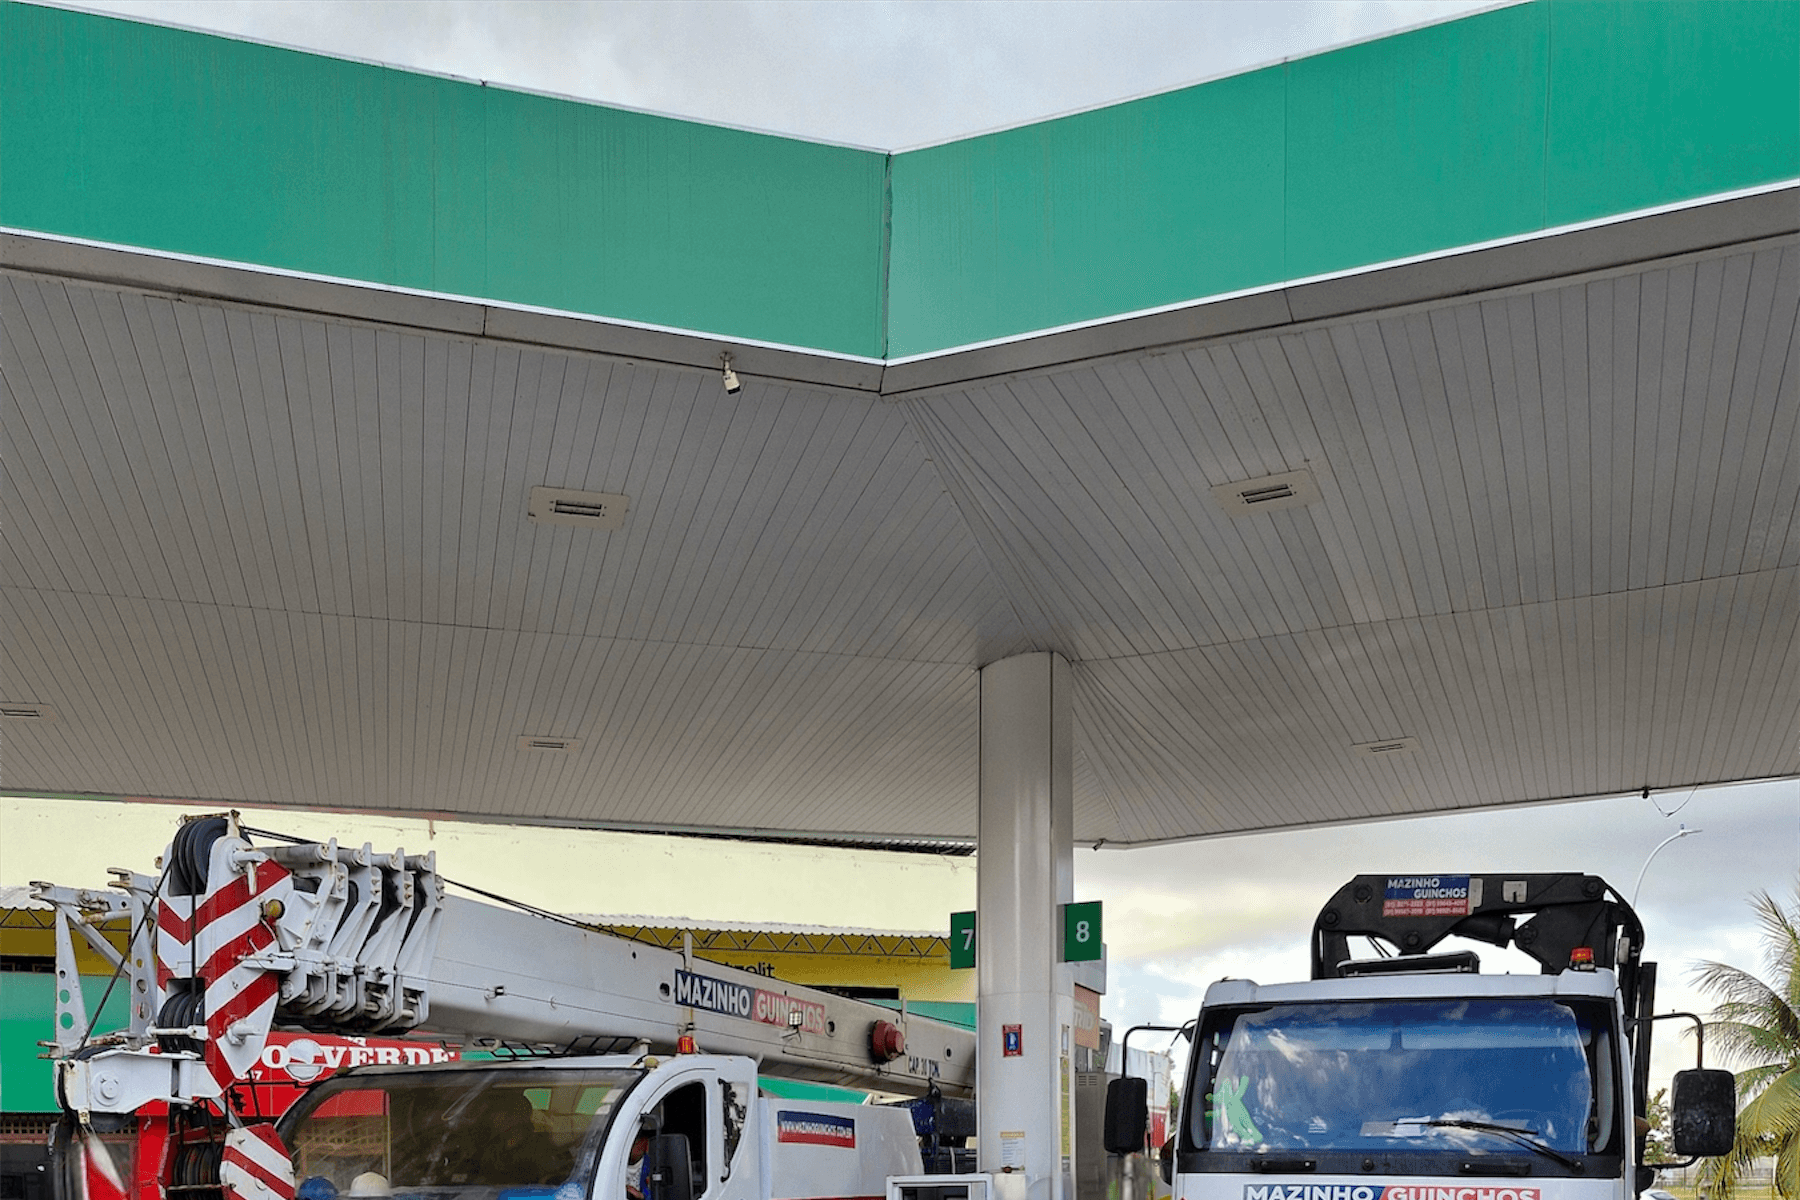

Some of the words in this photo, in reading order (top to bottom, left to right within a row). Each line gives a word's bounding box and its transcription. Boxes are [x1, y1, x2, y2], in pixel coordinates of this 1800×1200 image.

[1387, 878, 1440, 889] MAZINHO
[1413, 888, 1467, 899] GUINCHOS
[961, 929, 974, 950] 7
[1076, 921, 1090, 943] 8
[677, 973, 750, 1016] MAZINHO
[320, 1046, 455, 1067] VERDE
